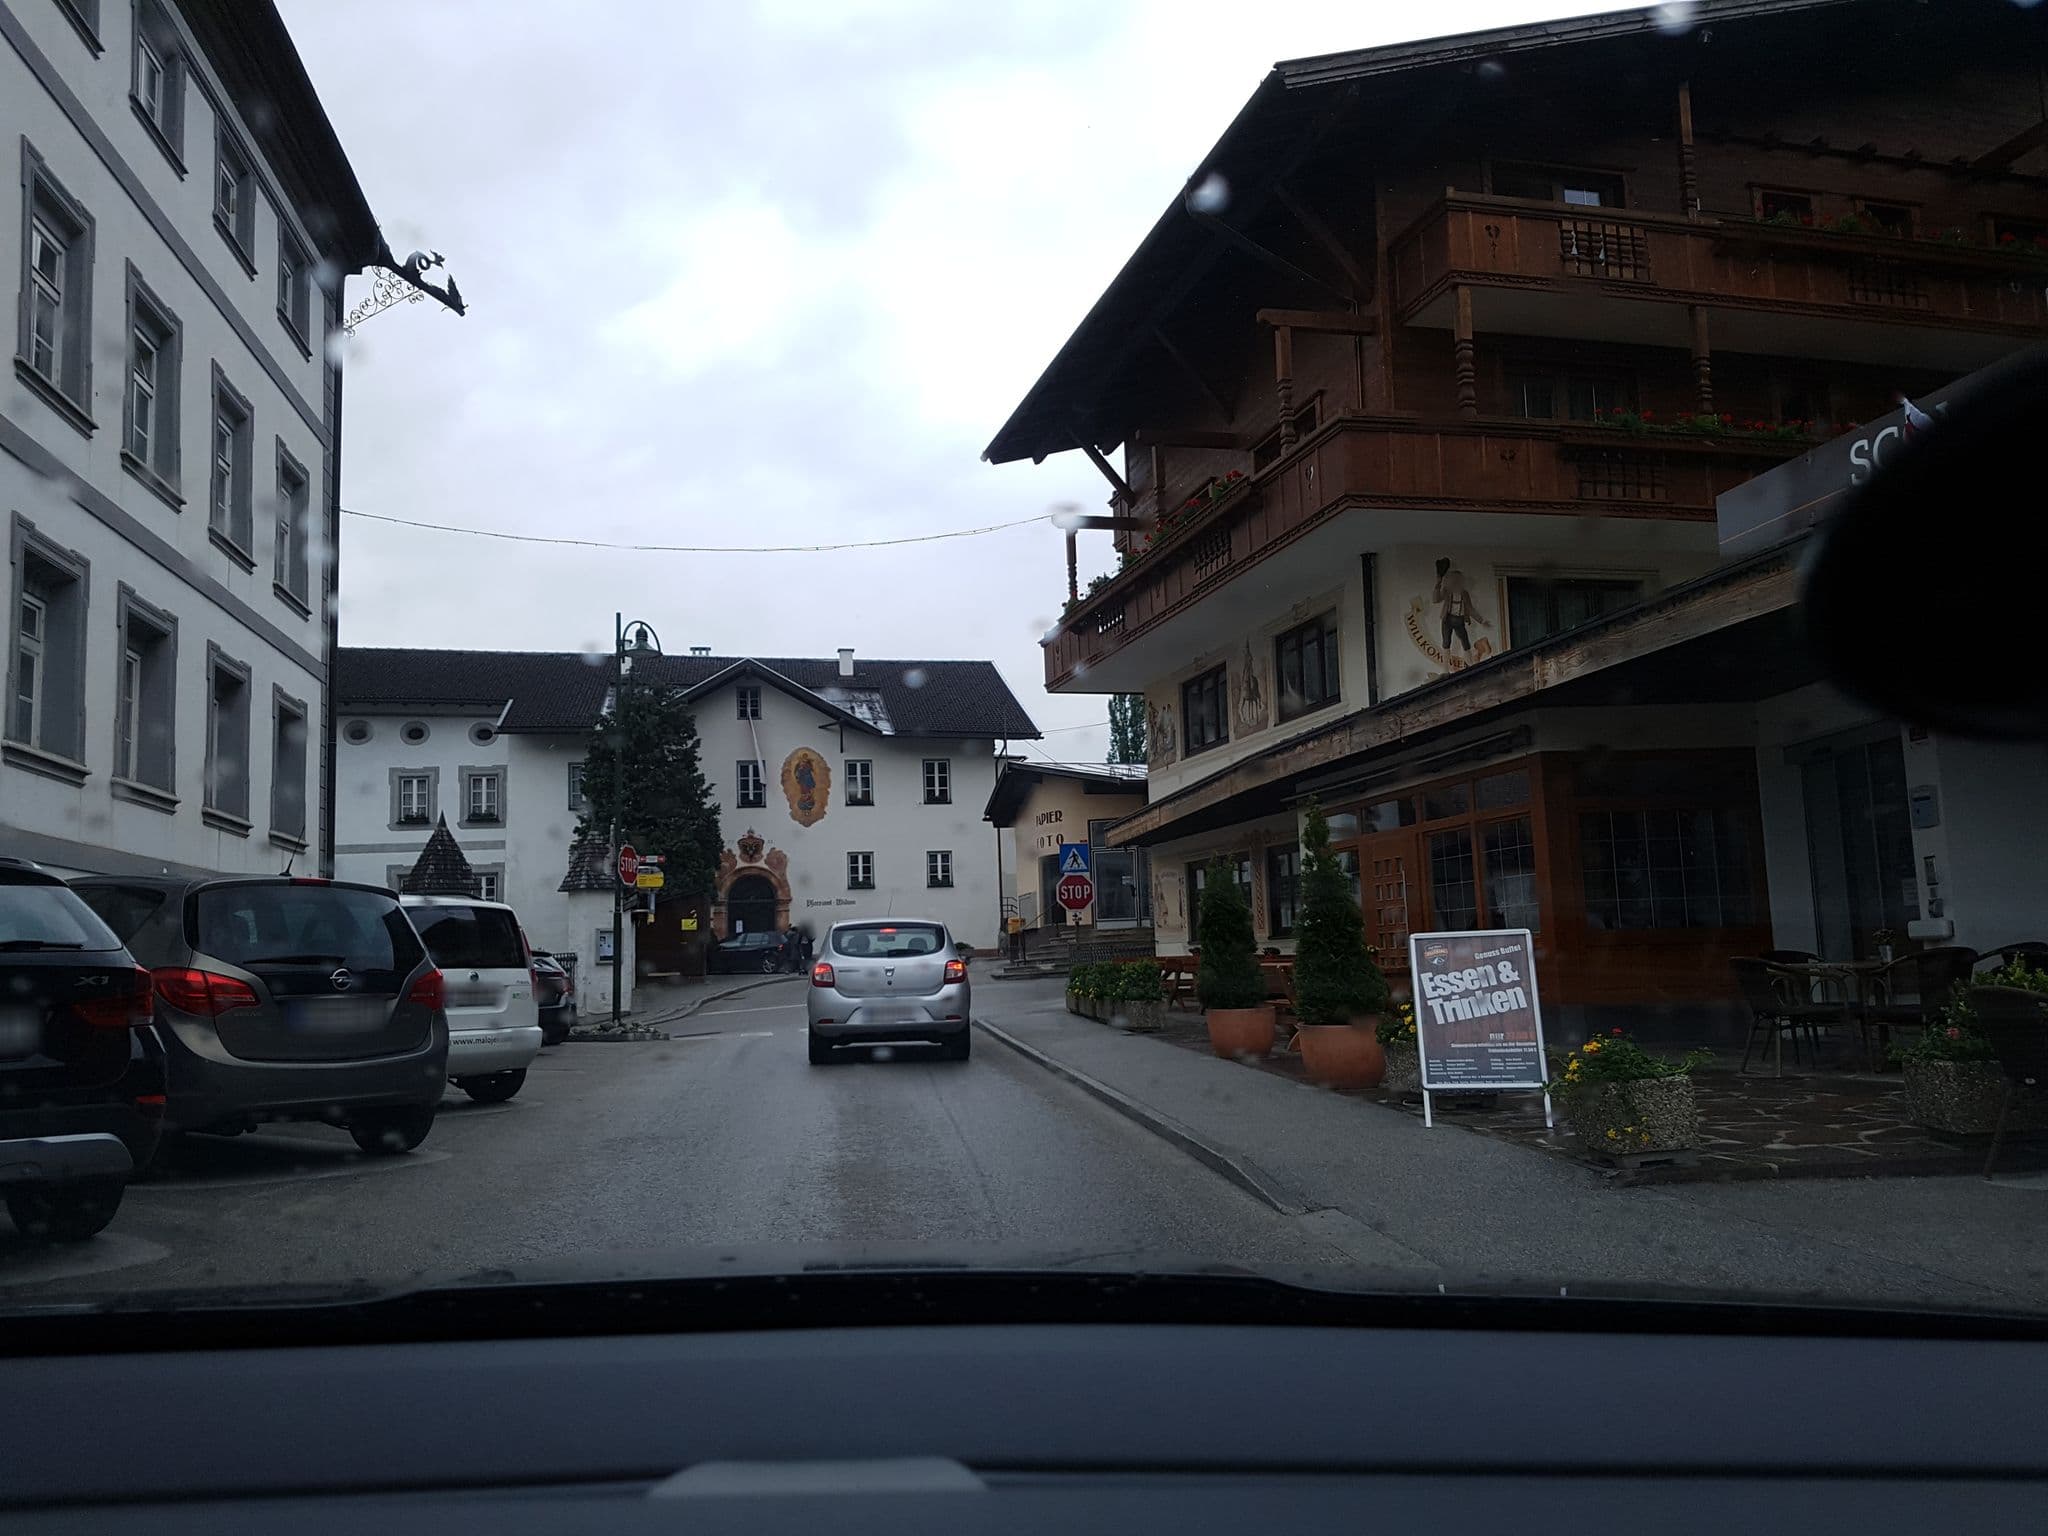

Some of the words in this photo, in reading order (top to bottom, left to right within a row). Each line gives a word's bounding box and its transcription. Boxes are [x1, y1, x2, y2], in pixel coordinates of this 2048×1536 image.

[1036, 810, 1063, 827] PAPIER
[621, 857, 638, 873] STOP
[1061, 885, 1091, 899] STOP
[1500, 944, 1522, 955] Buffet
[73, 975, 110, 987] X1
[1420, 964, 1497, 999] Essen
[1497, 960, 1520, 983] &
[1427, 986, 1528, 1025] Trinken
